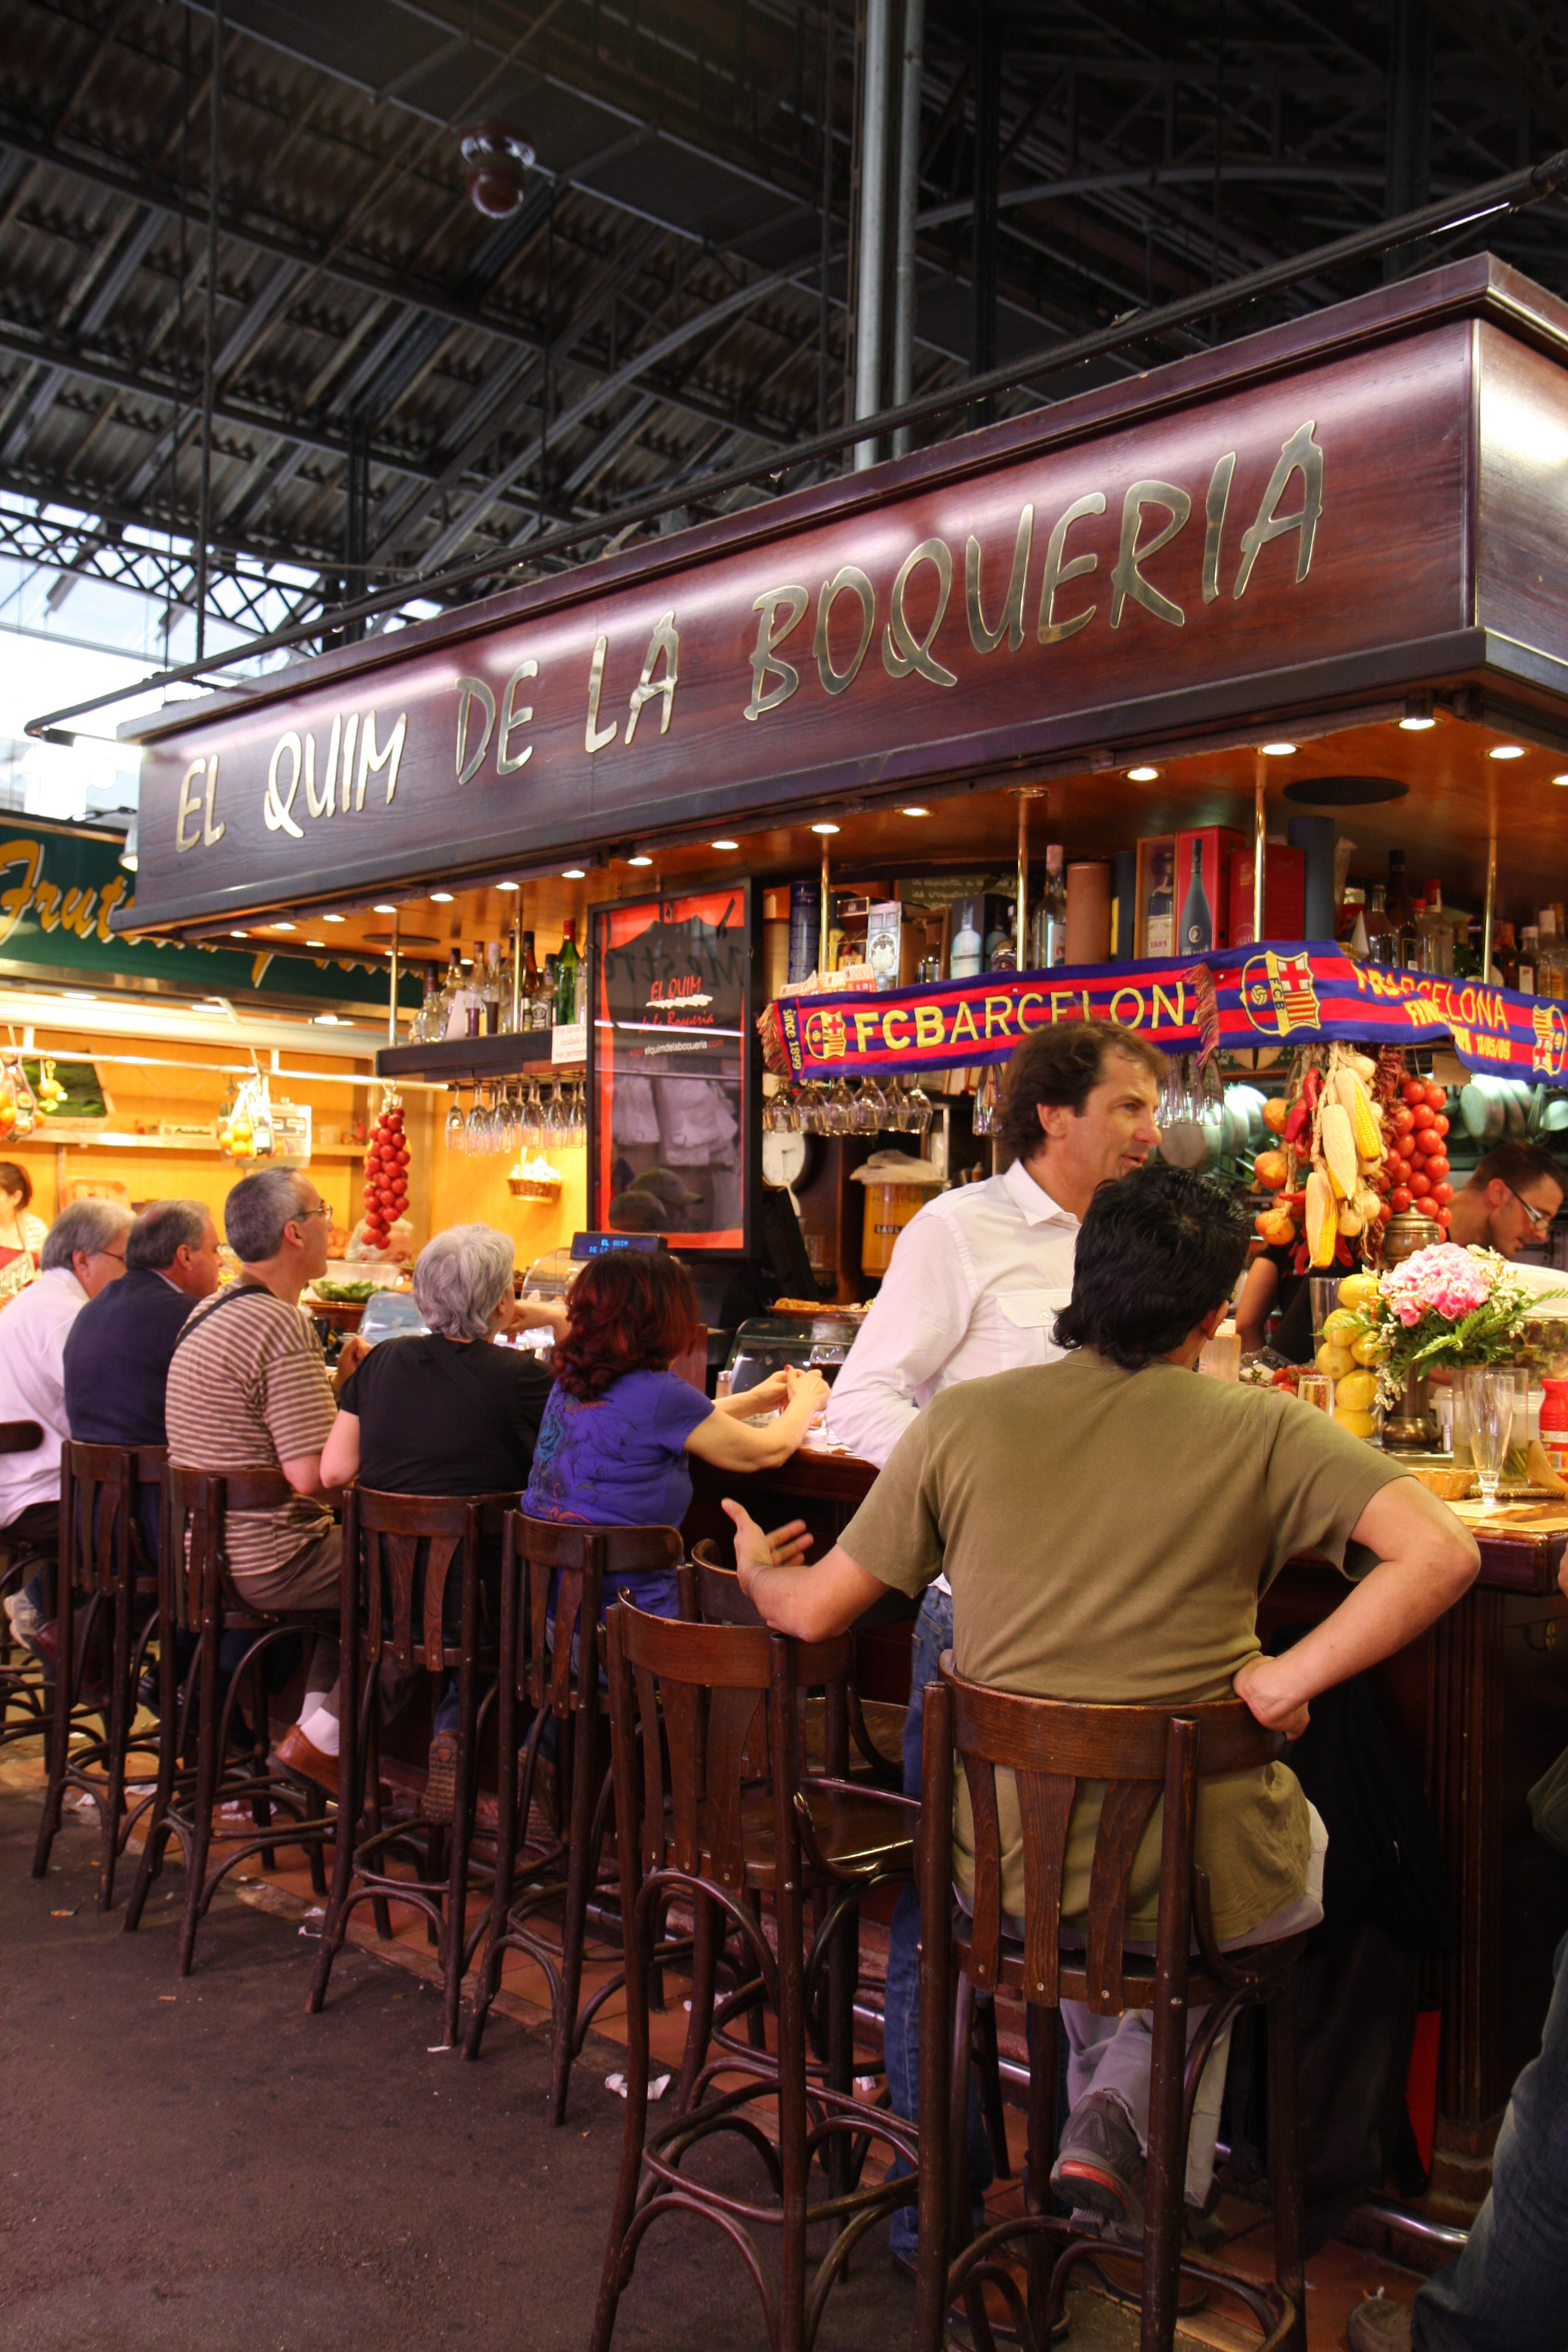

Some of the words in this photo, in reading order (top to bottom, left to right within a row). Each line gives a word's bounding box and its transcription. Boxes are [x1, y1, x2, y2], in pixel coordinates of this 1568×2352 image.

[176, 754, 226, 853] EL
[264, 710, 407, 838] QUIM
[454, 659, 538, 785] DE
[585, 610, 679, 753] LA
[743, 420, 1324, 721] BOQUERIA
[650, 981, 664, 1001] EL
[667, 976, 702, 1001] QUIM
[1270, 978, 1285, 1010] FCB
[783, 1008, 797, 1039] Since
[854, 981, 1199, 1054] FCBARCELON
[789, 1040, 802, 1070] 1899
